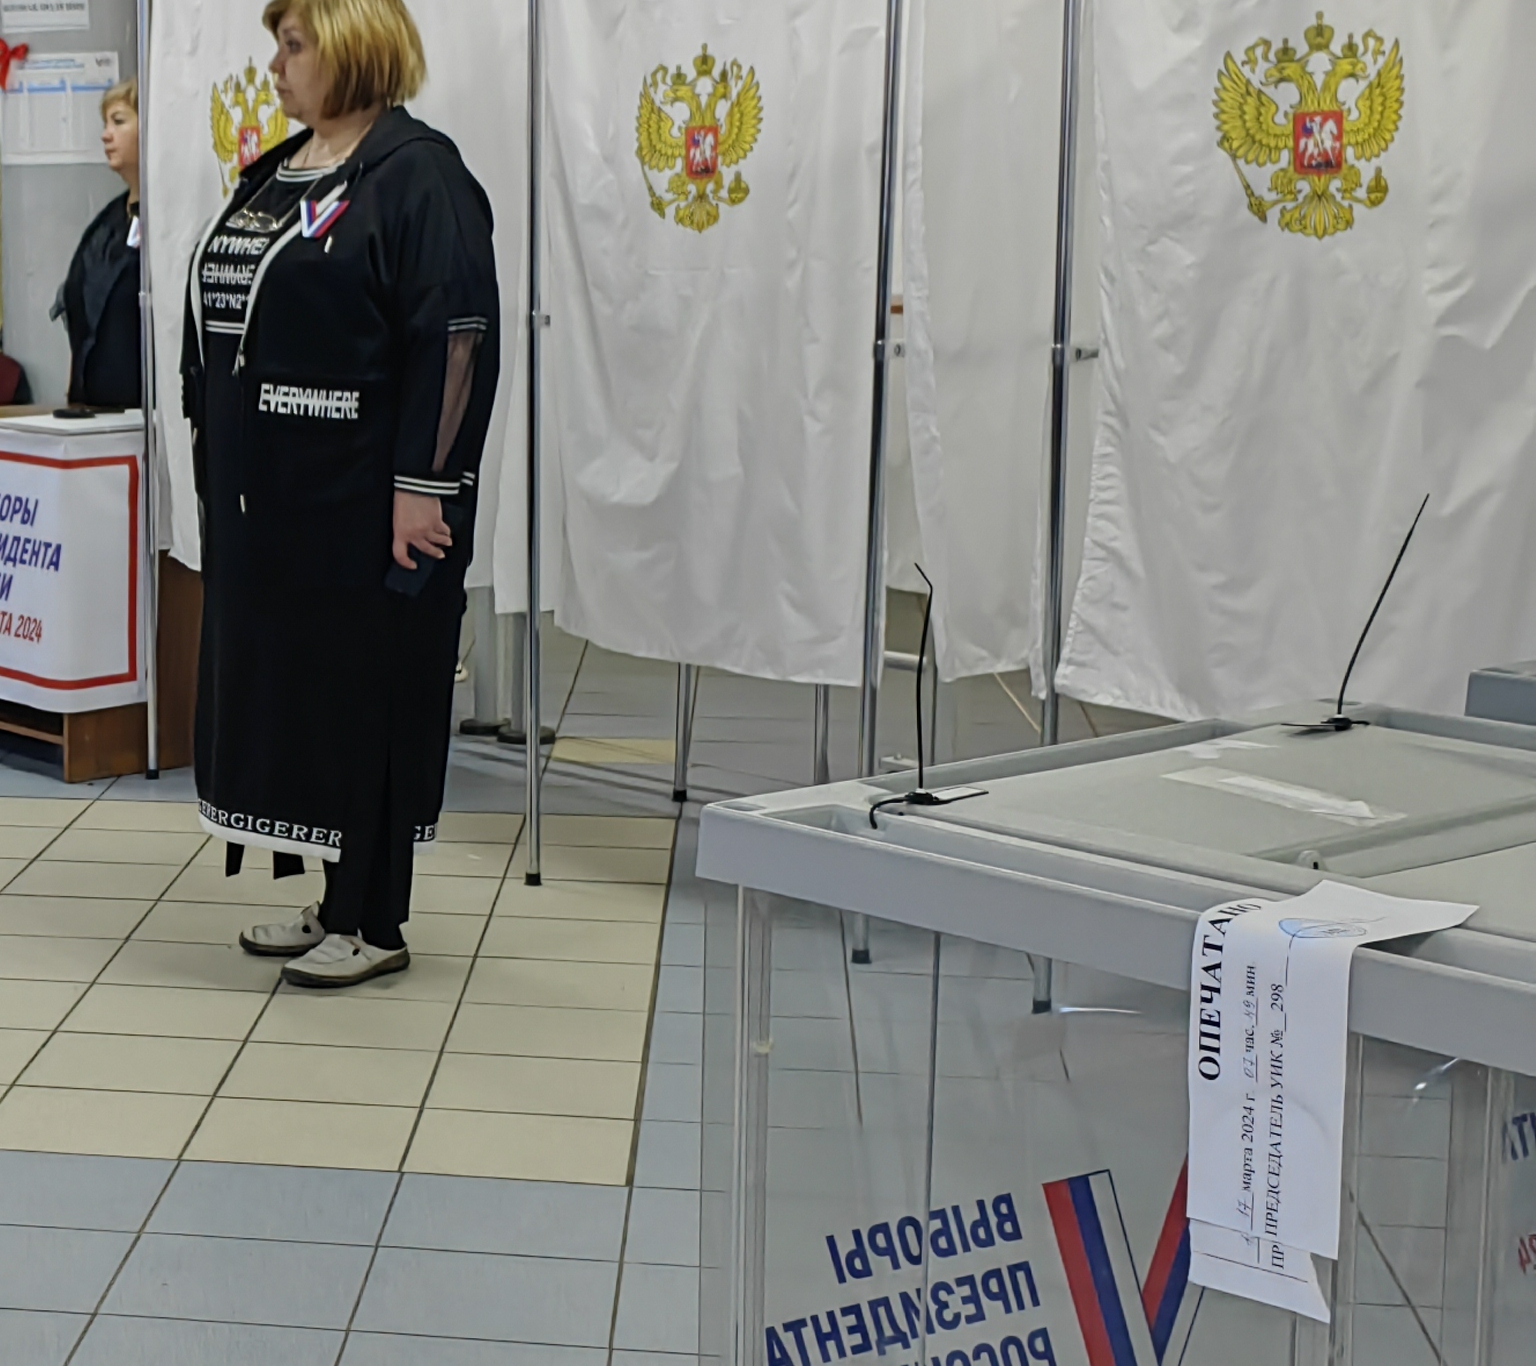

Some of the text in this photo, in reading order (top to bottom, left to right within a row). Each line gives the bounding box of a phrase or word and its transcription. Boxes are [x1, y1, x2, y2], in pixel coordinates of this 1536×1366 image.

[258, 383, 360, 419] EVERYWHERE
[14, 615, 43, 644] 2024
[1198, 902, 1262, 1081] ОПЕЧАТАНО
[1270, 983, 1284, 1012] 298
[1270, 1050, 1284, 1089] УИК
[1240, 1105, 1255, 1142] 2024
[1240, 1146, 1254, 1192] марта
[1264, 1094, 1284, 1236] ПРЕДСЕДАТЕЛЬ
